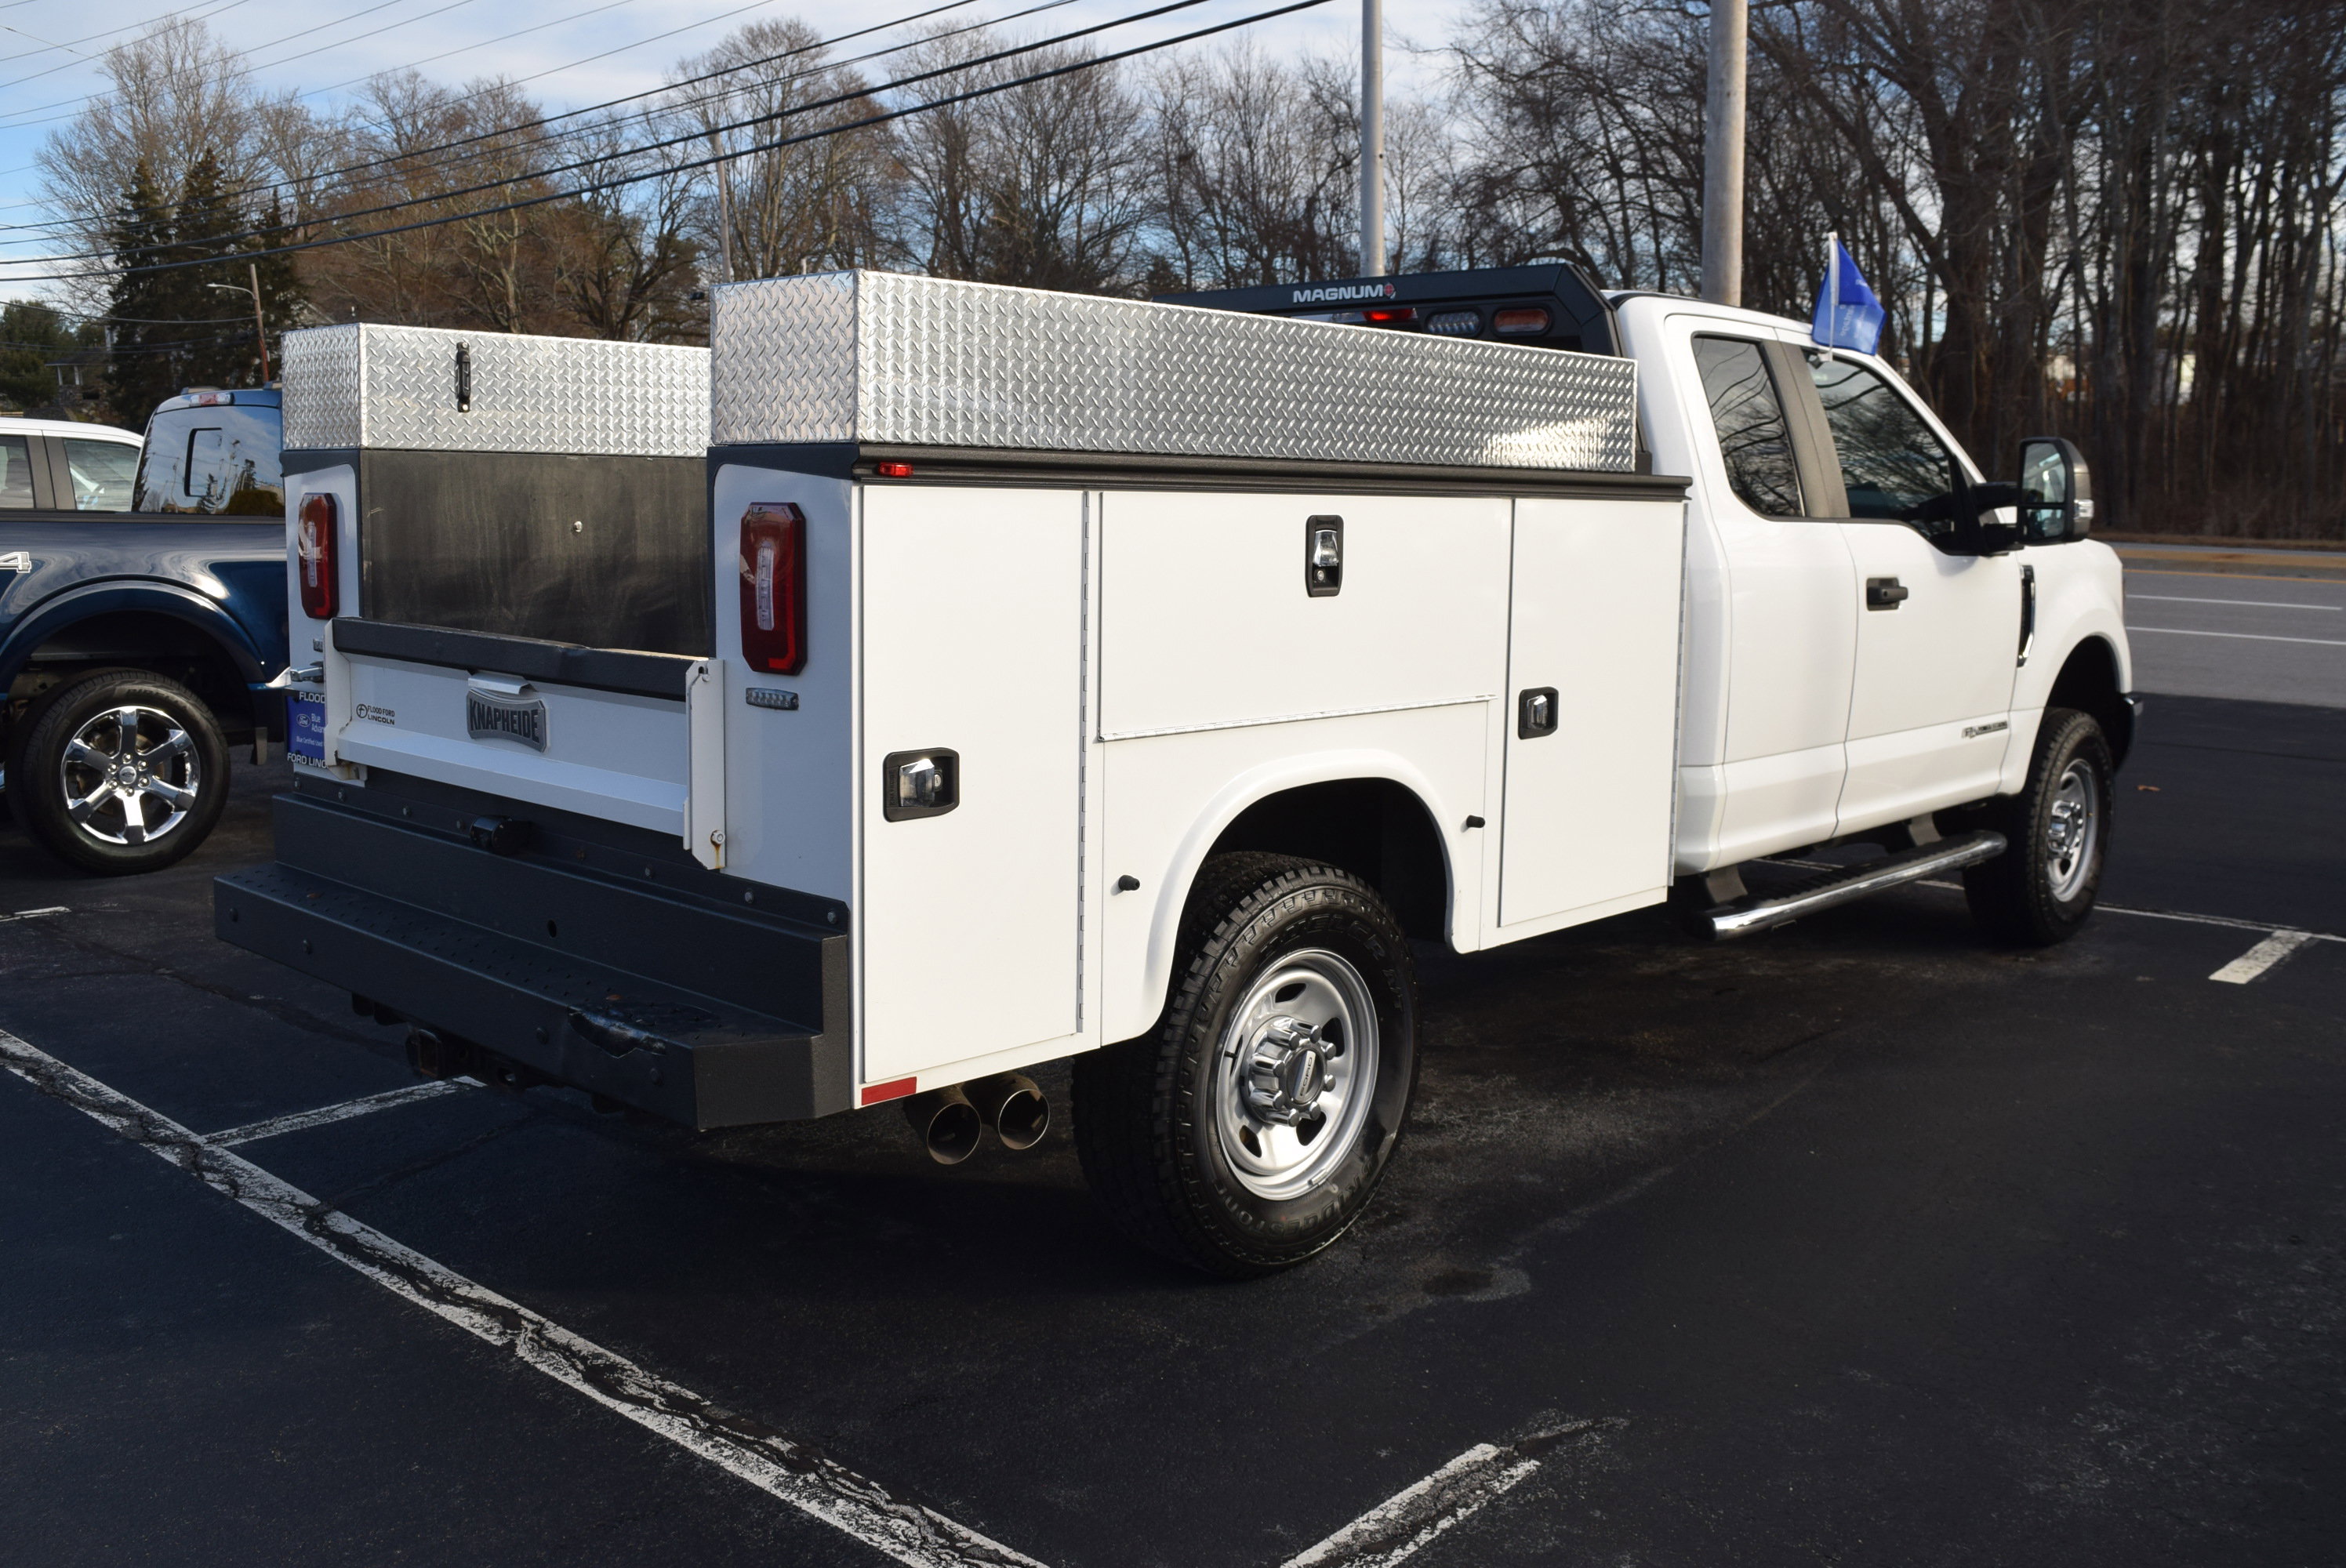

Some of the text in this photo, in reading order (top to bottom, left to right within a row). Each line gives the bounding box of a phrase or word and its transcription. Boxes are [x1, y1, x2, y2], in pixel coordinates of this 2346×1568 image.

[1293, 284, 1383, 303] MAGNUM
[299, 691, 325, 704] FLOOD
[367, 705, 395, 717] FLOOD FORD
[368, 714, 395, 725] LINCOLN
[470, 699, 539, 742] KNAPHEIDE
[287, 752, 328, 769] FORD LINC
